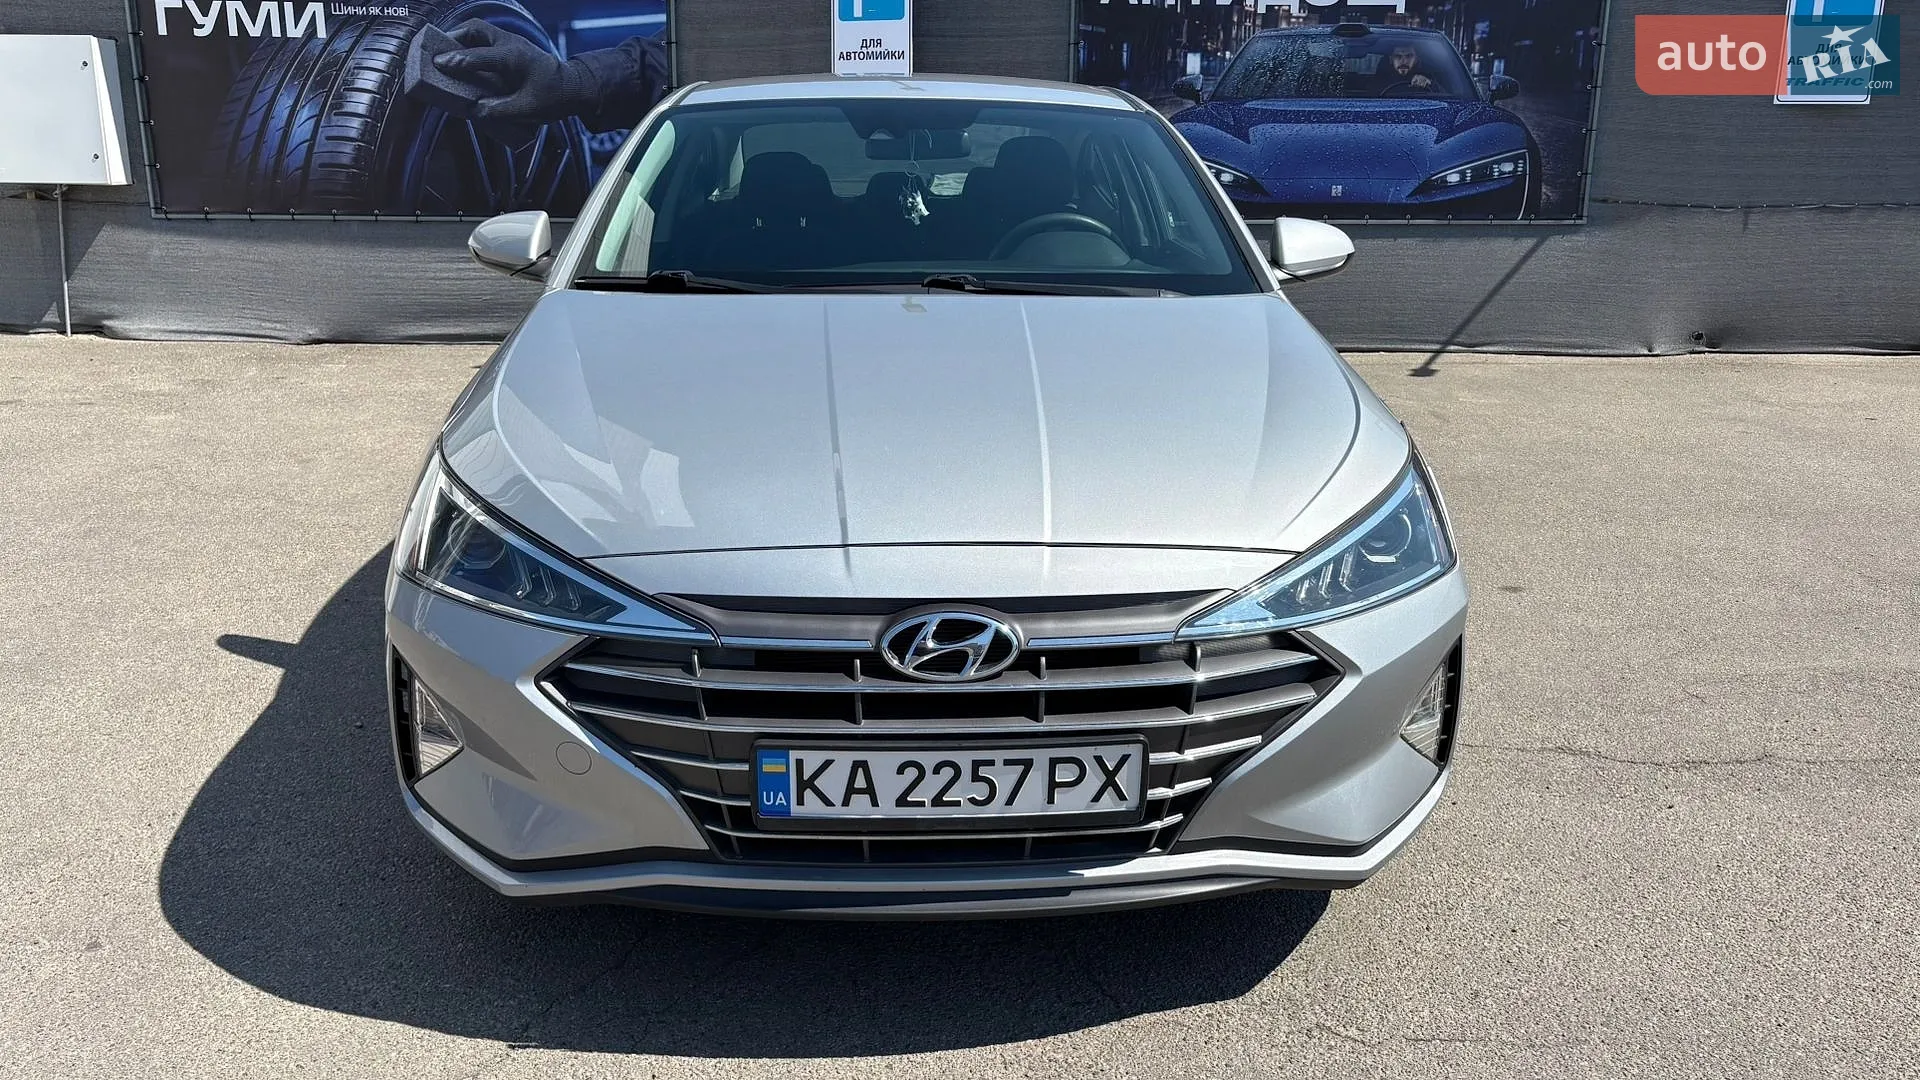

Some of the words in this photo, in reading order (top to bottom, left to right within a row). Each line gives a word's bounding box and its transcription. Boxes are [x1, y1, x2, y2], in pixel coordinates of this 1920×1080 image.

[330, 2, 367, 15] Шини
[368, 6, 383, 16] як
[384, 4, 409, 17] нові
[154, 0, 328, 39] ГУМИ
[860, 38, 882, 50] ДЛЯ
[838, 48, 905, 61] АВТОМИЙКИ
[1787, 54, 1866, 66] АВОИКИ
[1786, 77, 1865, 87] TRAFFIC
[795, 758, 880, 808] KA
[894, 757, 1034, 808] 2257
[1046, 752, 1133, 804] PX
[763, 790, 788, 807] UA
